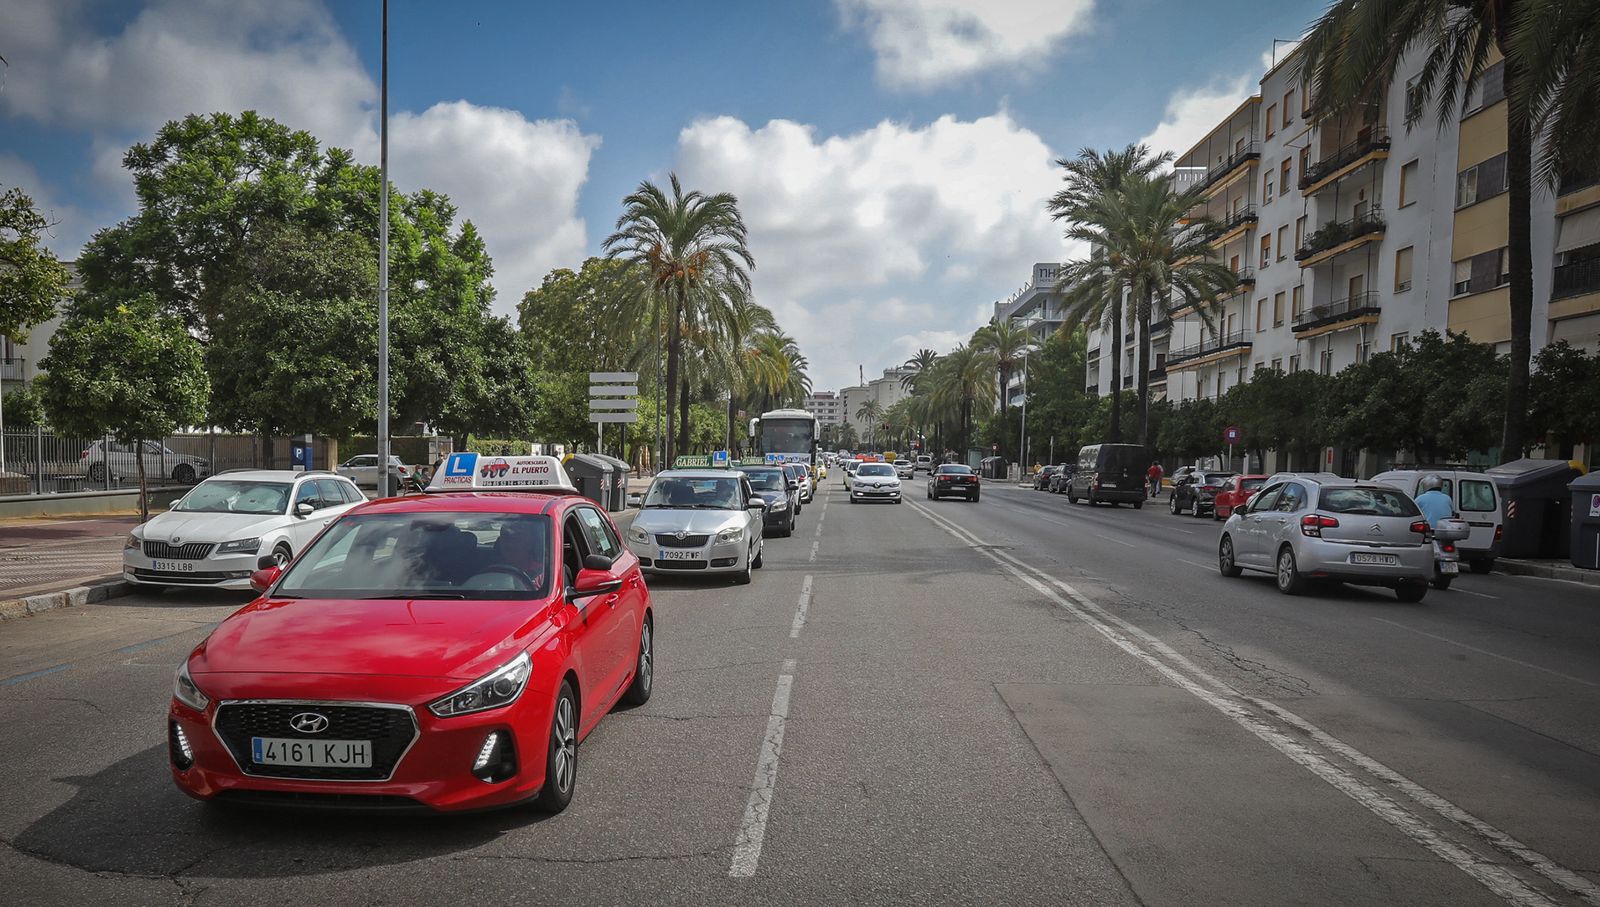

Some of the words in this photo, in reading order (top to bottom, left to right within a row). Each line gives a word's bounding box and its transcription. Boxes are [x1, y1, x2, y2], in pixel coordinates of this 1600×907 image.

[296, 448, 302, 458] P
[452, 456, 467, 473] L
[676, 458, 710, 467] GABRIEL
[521, 466, 549, 474] PUERTO
[665, 551, 684, 559] 7092
[157, 561, 176, 570] 3315
[177, 562, 193, 571] LBB
[266, 742, 314, 762] 4161
[324, 744, 365, 764] KJH
